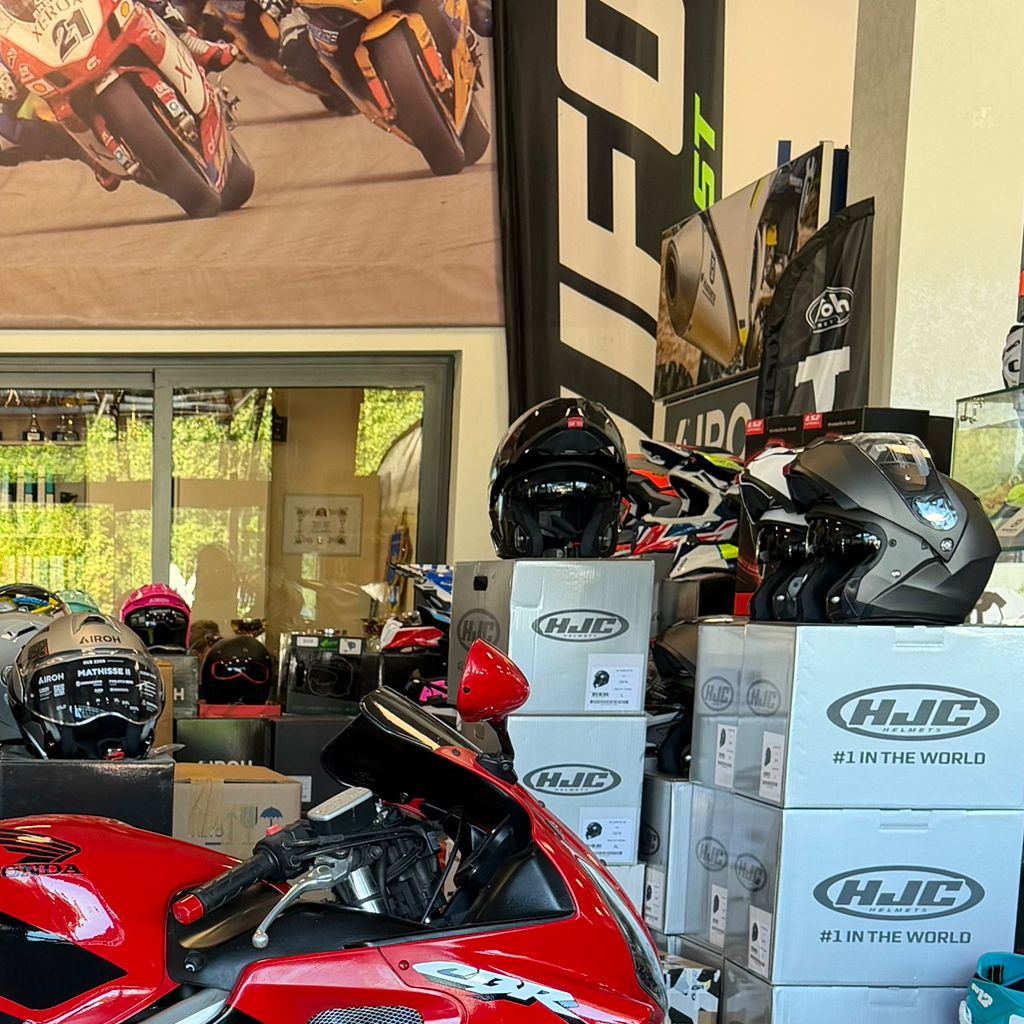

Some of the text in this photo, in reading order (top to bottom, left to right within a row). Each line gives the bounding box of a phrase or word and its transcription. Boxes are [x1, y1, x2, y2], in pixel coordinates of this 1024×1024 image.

[51, 7, 94, 63] 21
[544, 618, 617, 634] HJC
[79, 635, 122, 645] AIROH
[38, 672, 65, 685] AIROH
[77, 667, 124, 677] MATHISSE
[704, 686, 730, 702] HJC
[848, 699, 978, 726] HJC
[833, 751, 986, 765] #1 IN THE WORLD
[536, 772, 610, 788] HJC
[836, 880, 966, 906] HJC
[820, 930, 972, 944] #1 IN THE WORLD
